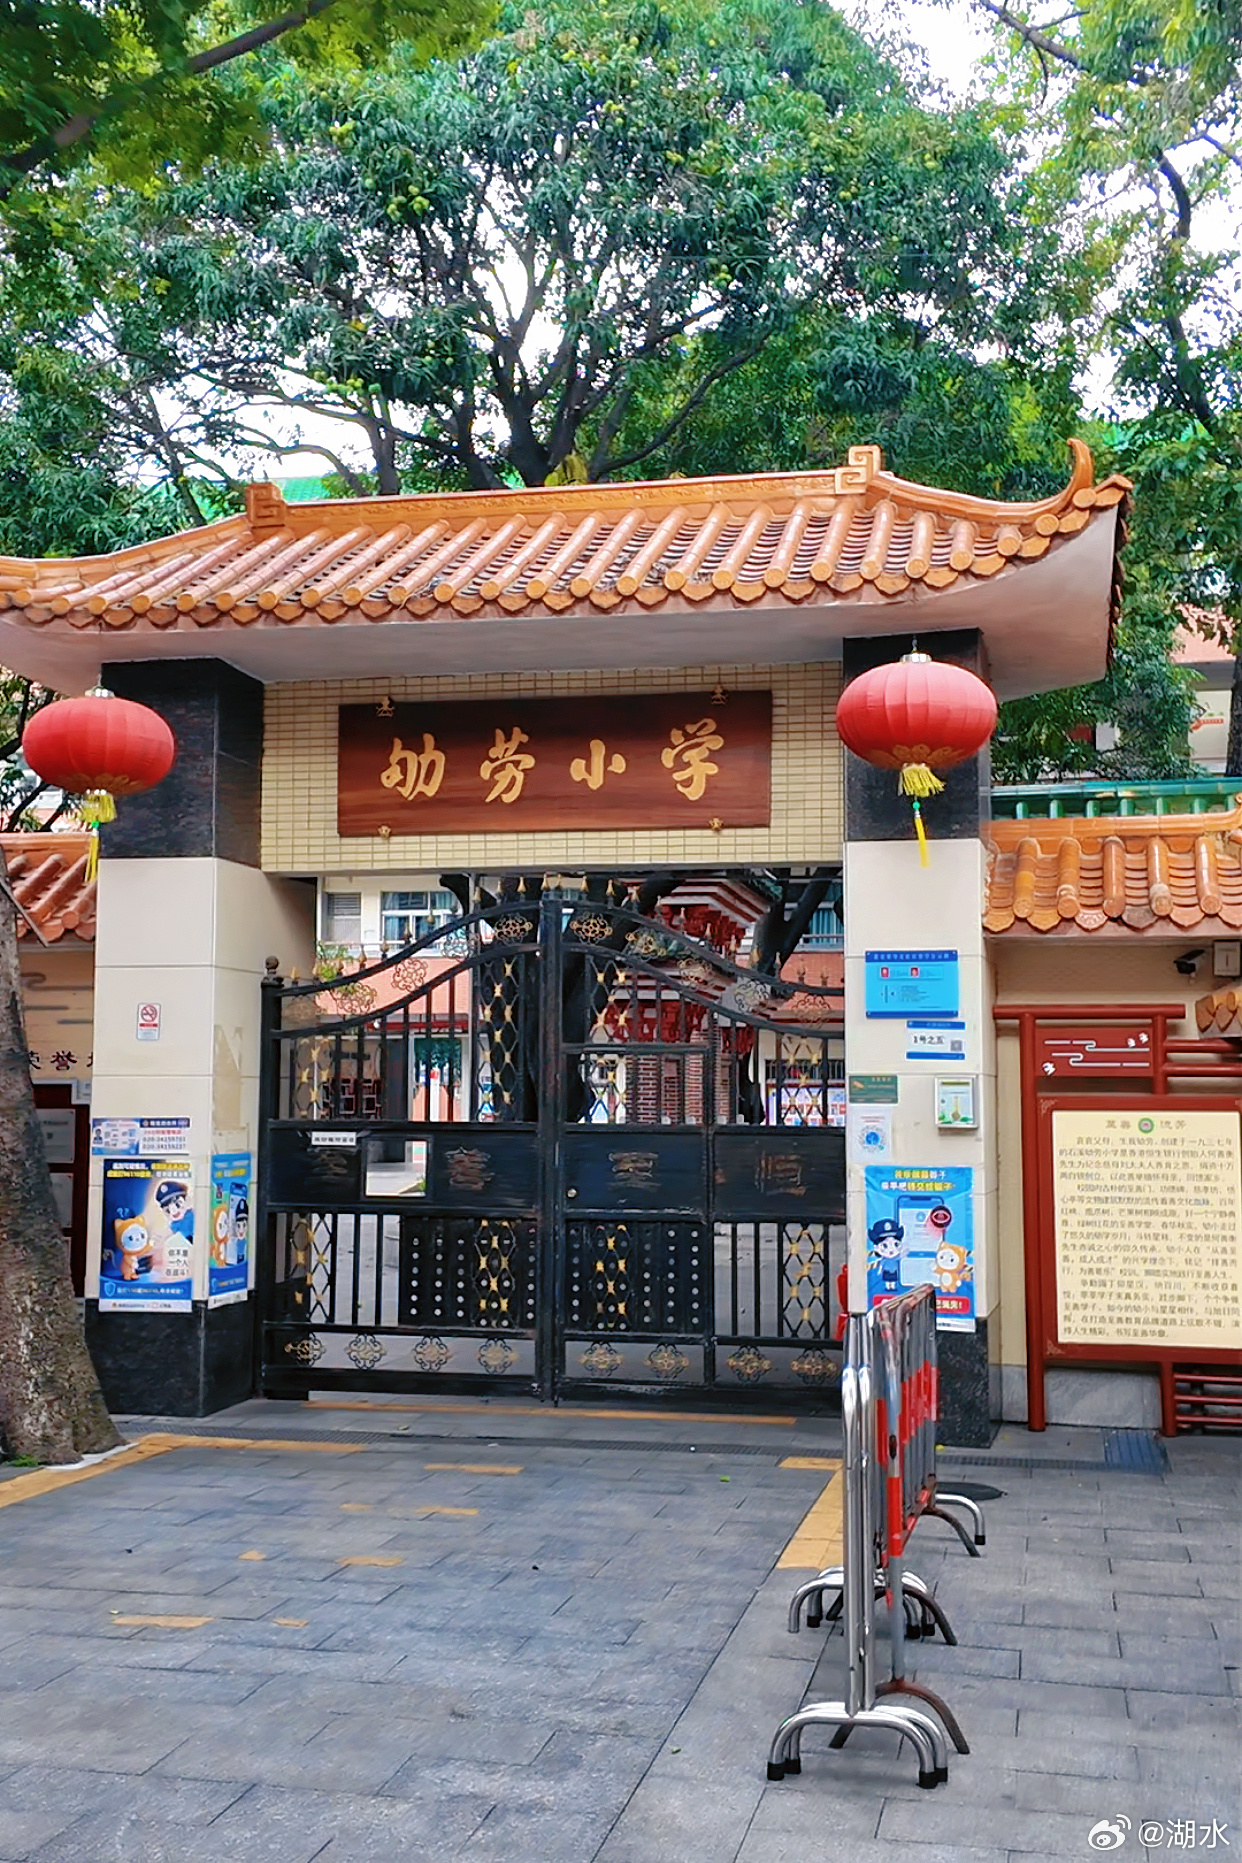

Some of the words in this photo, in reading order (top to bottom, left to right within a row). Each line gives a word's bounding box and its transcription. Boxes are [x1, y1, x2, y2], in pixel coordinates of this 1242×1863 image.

[380, 717, 725, 804] 劬劳小学
[168, 1259, 188, 1267] 一个人
